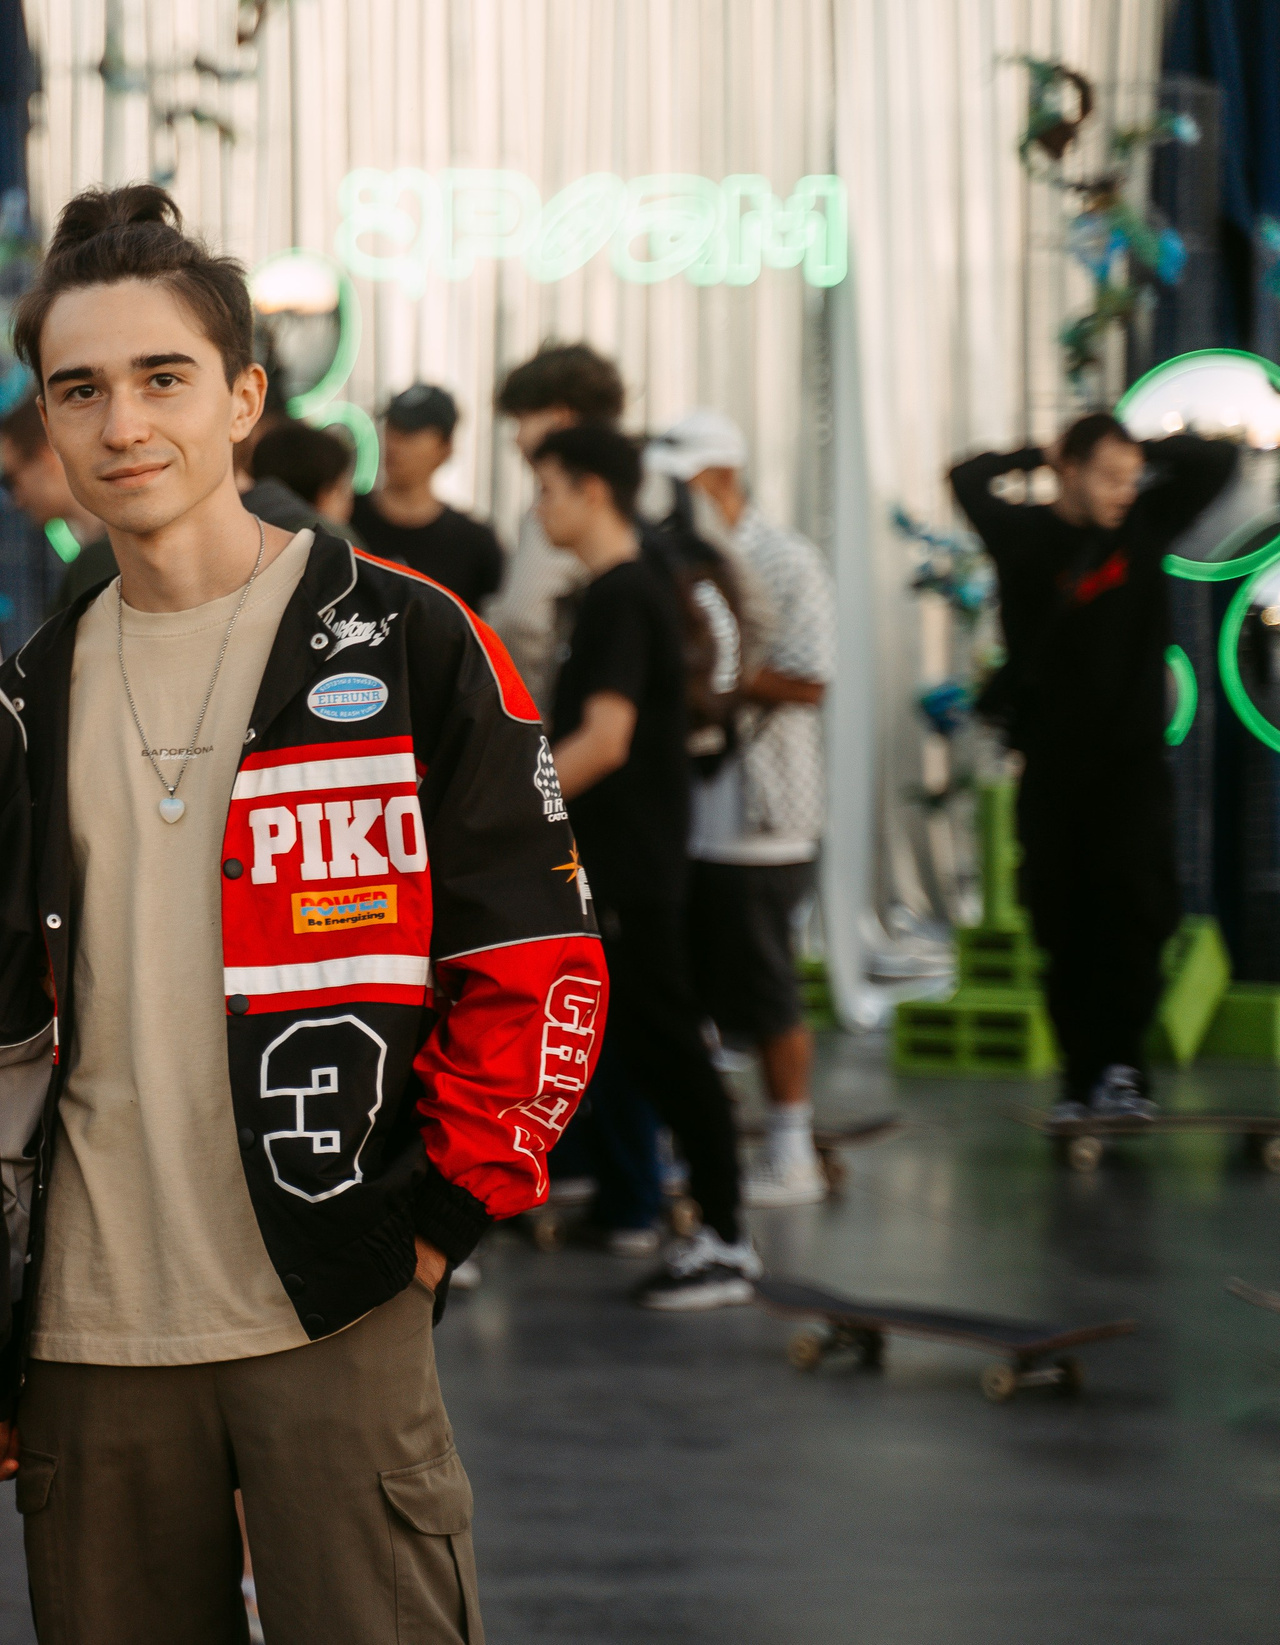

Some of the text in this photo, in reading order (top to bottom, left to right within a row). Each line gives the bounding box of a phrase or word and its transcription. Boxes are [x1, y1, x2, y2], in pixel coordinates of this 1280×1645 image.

[543, 798, 568, 815] DR
[248, 795, 429, 885] PIKO
[300, 891, 388, 916] POWER
[308, 912, 385, 926] Be Energizing
[261, 1014, 388, 1204] 3
